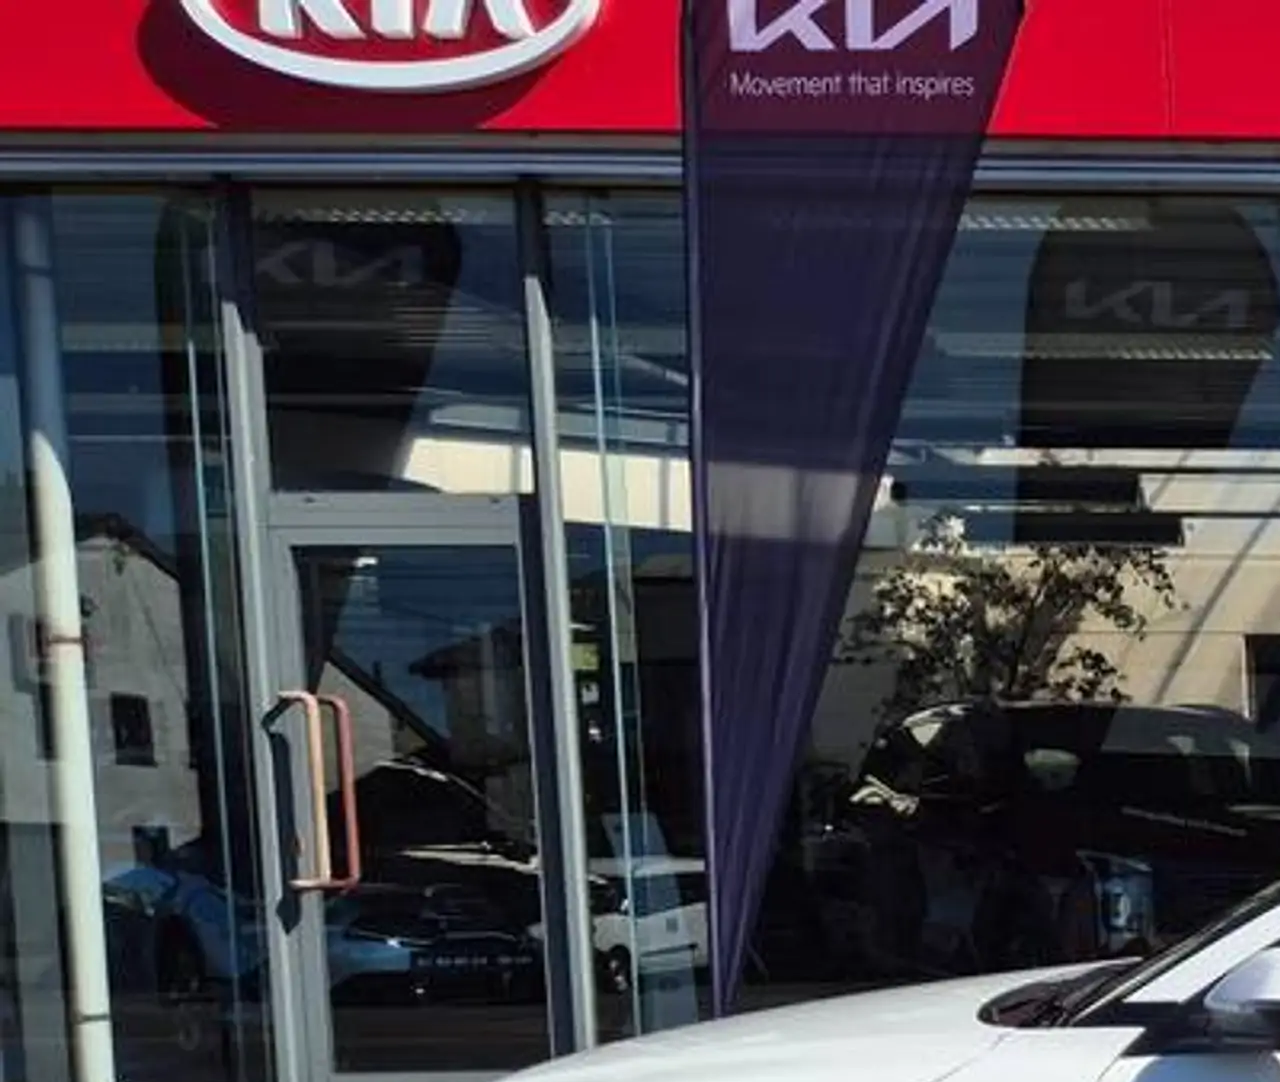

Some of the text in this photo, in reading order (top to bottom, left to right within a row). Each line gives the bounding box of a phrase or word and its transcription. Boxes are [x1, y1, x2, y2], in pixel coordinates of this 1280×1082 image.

[730, 71, 975, 101] Movement that inspires
